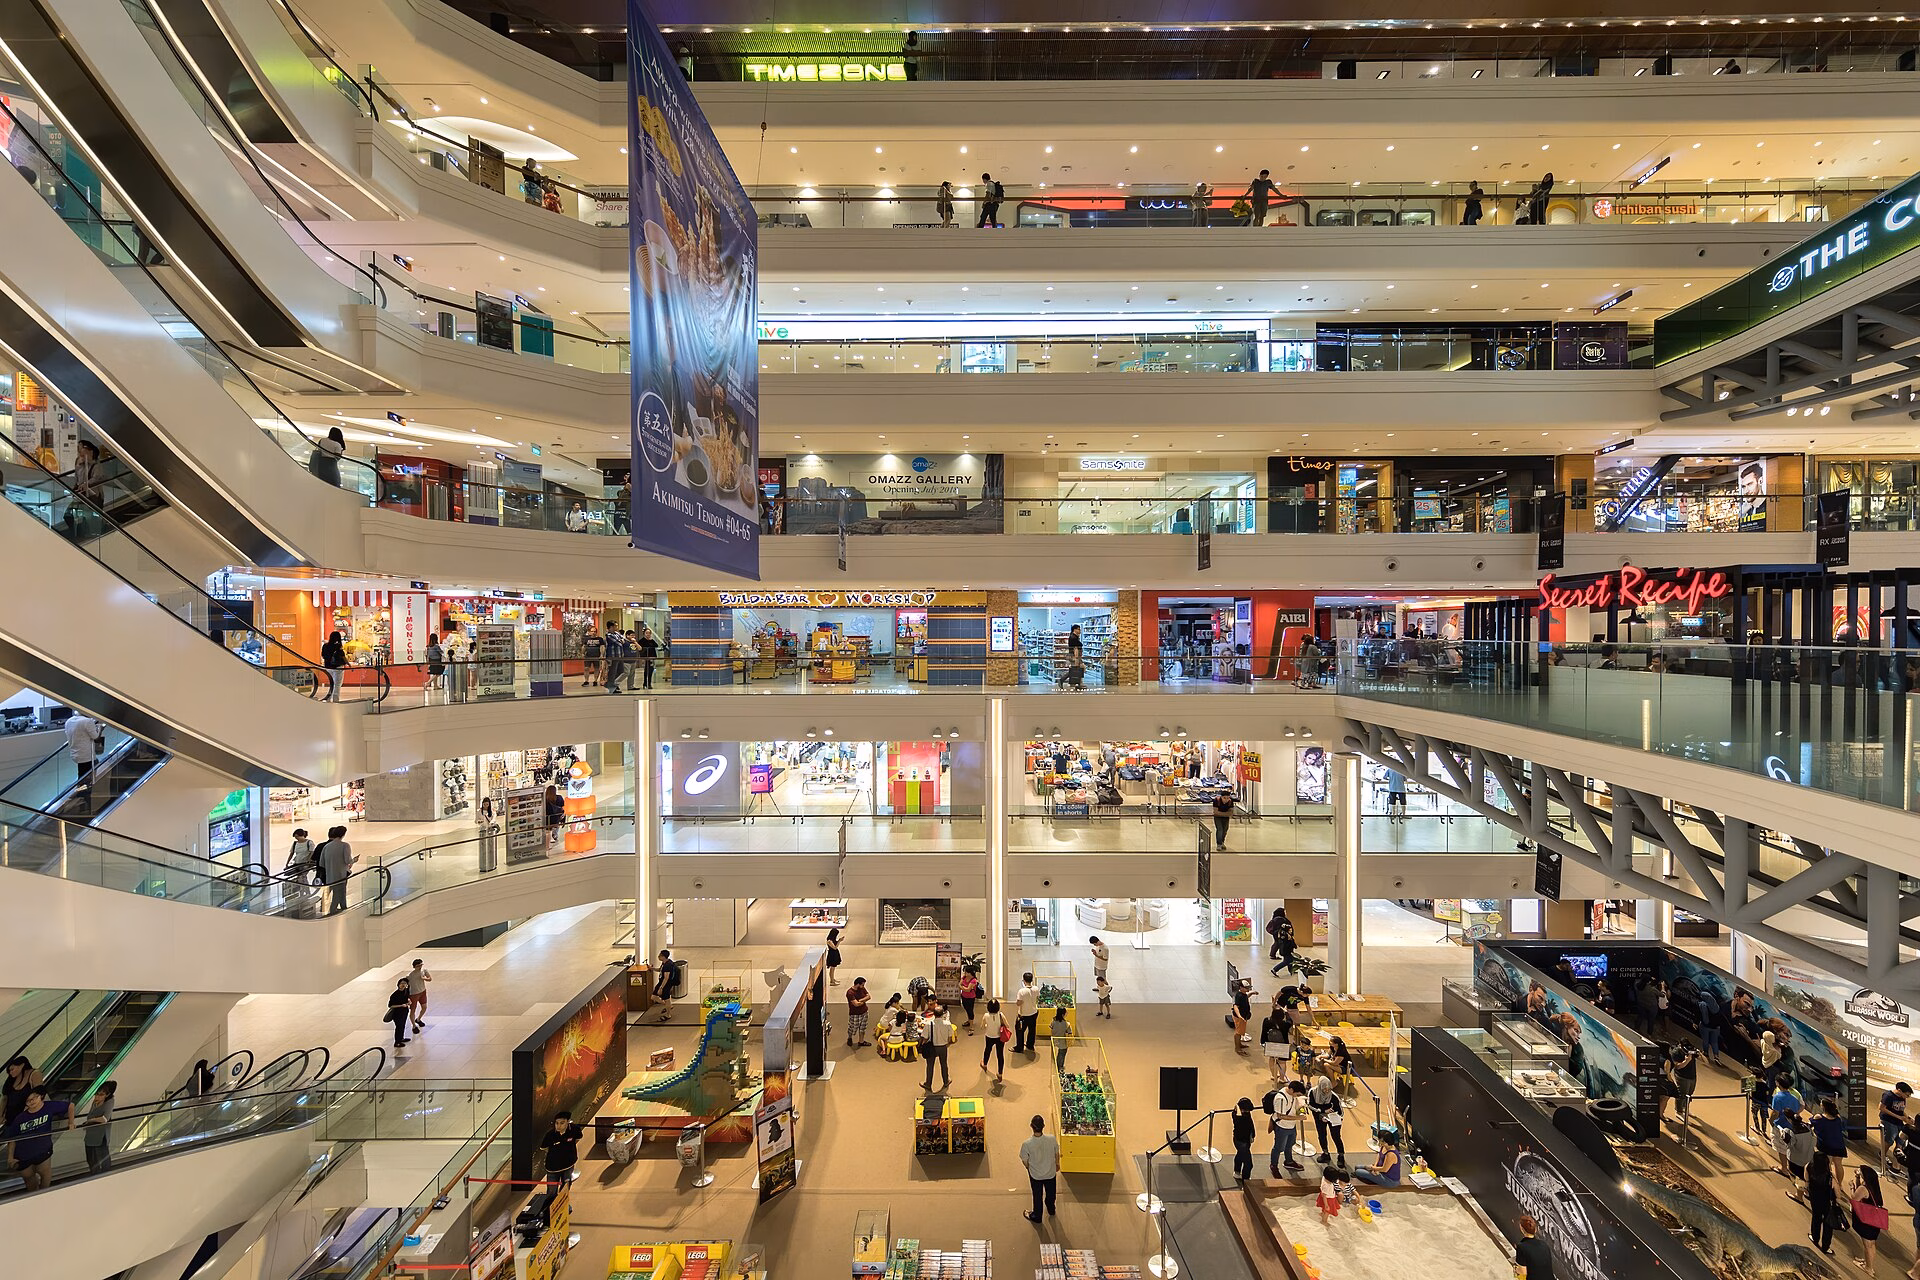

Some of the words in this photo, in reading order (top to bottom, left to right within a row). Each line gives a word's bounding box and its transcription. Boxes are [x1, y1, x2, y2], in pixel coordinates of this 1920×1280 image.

[746, 64, 907, 81] TIMEZONE
[662, 96, 680, 130] with
[681, 126, 695, 155] 128
[595, 203, 623, 211] Share
[1615, 204, 1662, 215] ichiban
[1664, 204, 1697, 215] sushi
[1800, 222, 1869, 278] THE
[644, 410, 670, 441] 第五代
[1082, 460, 1145, 469] Samsonite
[1287, 456, 1335, 472] times
[868, 475, 911, 484] OMAZZ
[915, 475, 973, 484] GALLERY
[882, 485, 920, 495] Opening
[921, 485, 938, 494] July
[1415, 501, 1430, 511] 25
[726, 514, 751, 541] #04-65
[1538, 573, 1614, 611] Secret
[1618, 565, 1733, 617] Recipe
[846, 592, 936, 605] WORKSHOP
[1280, 613, 1307, 624] AIBI
[752, 774, 766, 784] 40
[1244, 767, 1258, 779] $10
[1847, 1003, 1877, 1019] JURASSIC
[1876, 1010, 1907, 1025] WORLD
[1878, 1038, 1887, 1050] &
[1887, 1040, 1911, 1056] ROAR
[1505, 1169, 1558, 1241] JURASSIC
[632, 1253, 652, 1262] LEGO
[687, 1251, 707, 1260] LEGO
